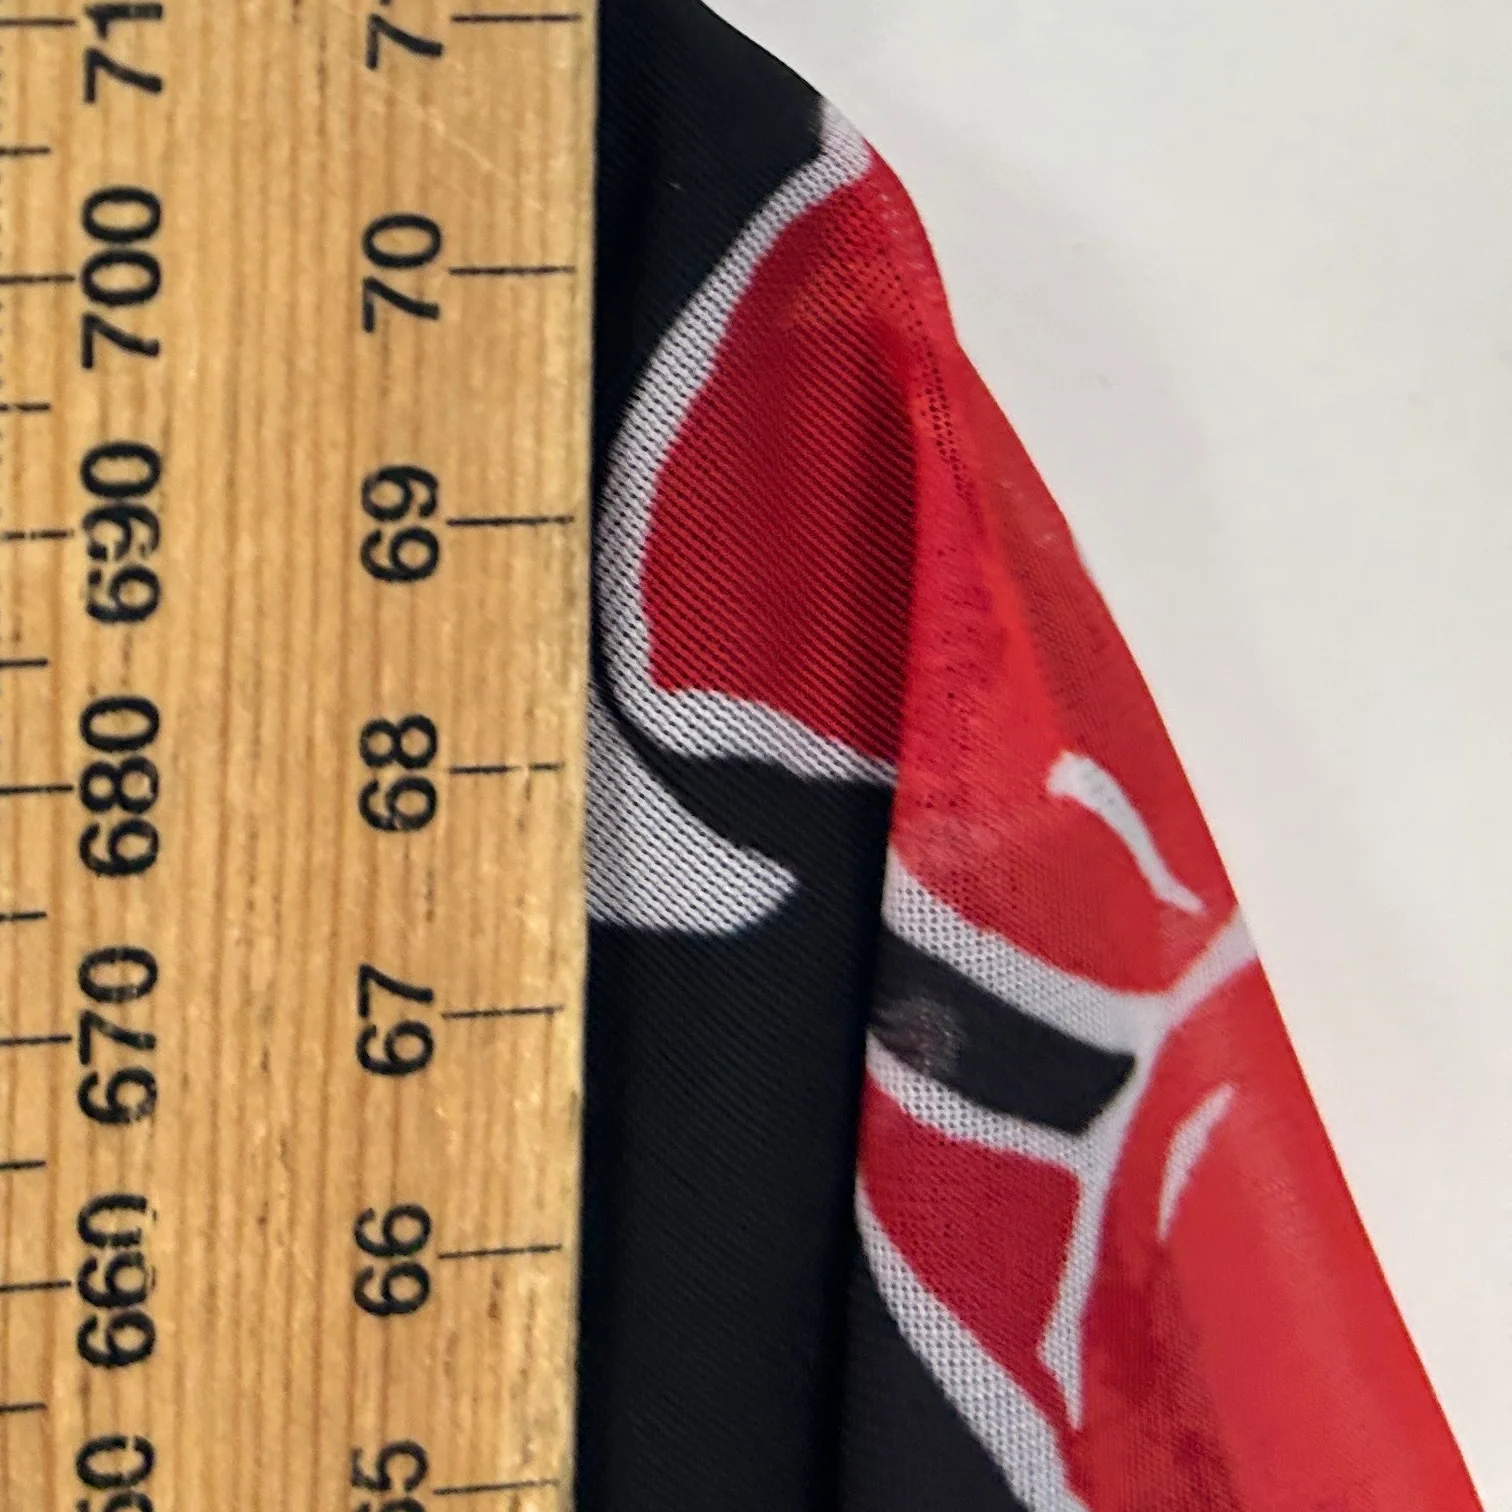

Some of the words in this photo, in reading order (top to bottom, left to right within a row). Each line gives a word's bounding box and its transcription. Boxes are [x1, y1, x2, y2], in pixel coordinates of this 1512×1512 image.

[79, 186, 162, 370] 700
[361, 213, 443, 334] 70
[79, 441, 163, 625] 690
[359, 465, 441, 584] 69
[78, 695, 161, 878] 680
[358, 714, 439, 834] 68
[76, 946, 159, 1127] 670
[355, 963, 435, 1079] 67
[76, 1193, 157, 1371] 660
[352, 1203, 433, 1320] 66
